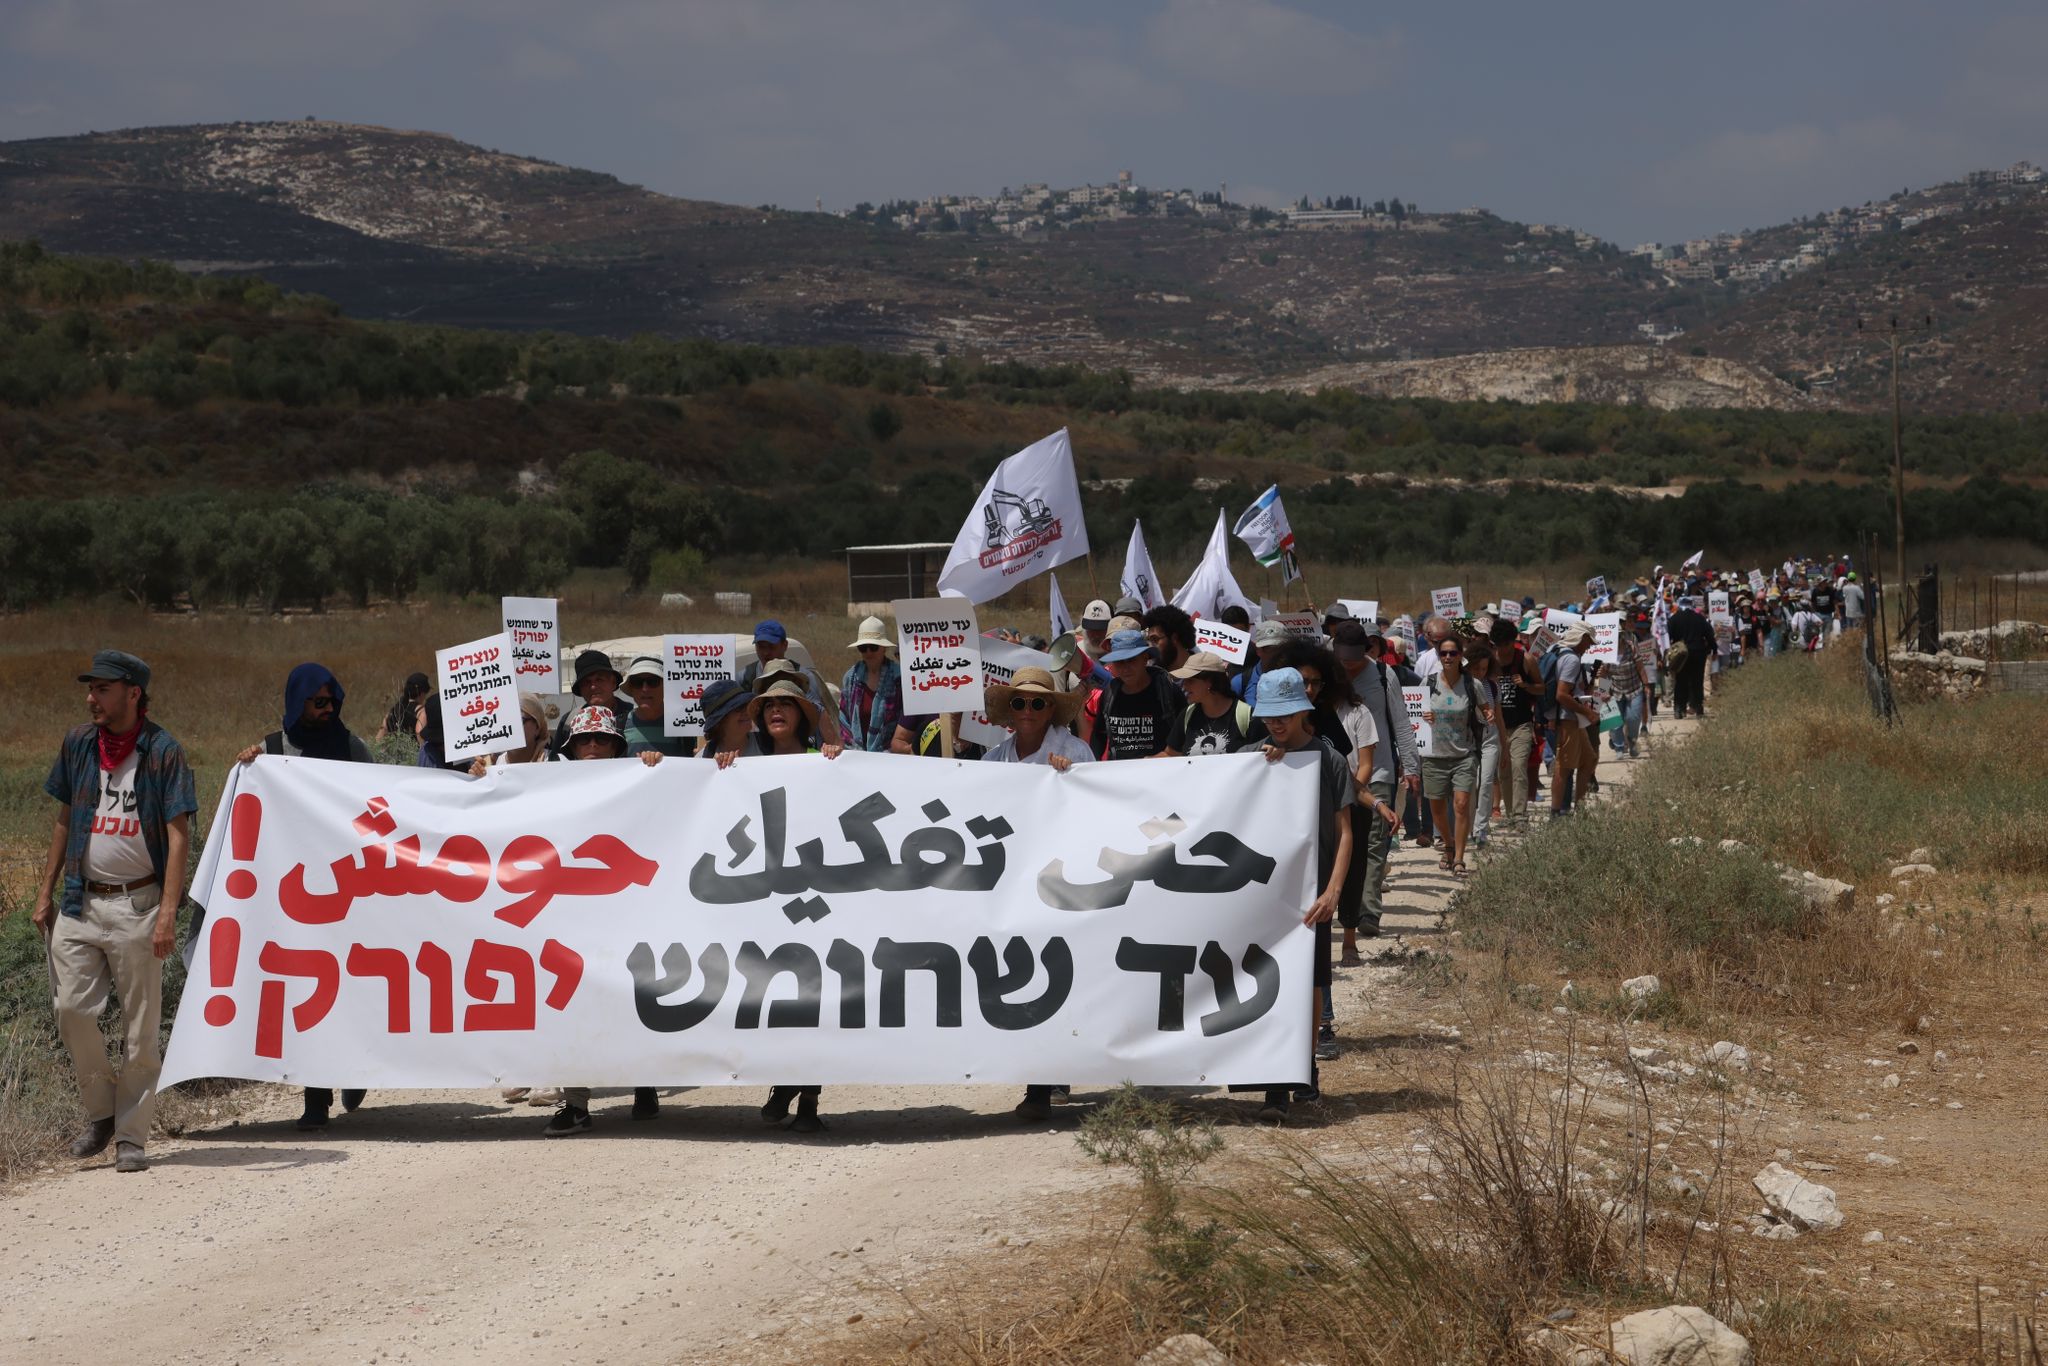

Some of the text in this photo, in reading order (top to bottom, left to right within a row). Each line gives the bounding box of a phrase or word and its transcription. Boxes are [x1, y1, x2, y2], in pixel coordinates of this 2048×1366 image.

[507, 619, 553, 629] עד שחומש
[903, 619, 971, 634] עד שחומש
[514, 629, 548, 644] יפורק!
[914, 634, 965, 654] יפורק!
[1197, 637, 1239, 653] سلام
[1199, 627, 1242, 645] שלום
[448, 647, 499, 671] עוצרים
[512, 647, 551, 660] حتى تفكيك
[674, 645, 724, 656] עוצרים
[675, 659, 722, 668] את טרור
[909, 656, 971, 673] حتى تفكيك
[982, 660, 1017, 678] חומש
[450, 663, 500, 683] את טרור
[667, 669, 731, 681] המתנחלים!
[444, 675, 512, 700] המתנחלים!
[681, 684, 704, 699] قف
[460, 695, 500, 716] نوقف
[1410, 702, 1422, 710] את
[466, 714, 497, 734] ارهاب
[1118, 726, 1153, 734] עם כיבוש
[1141, 717, 1153, 726] אין
[454, 725, 512, 749] المستوطنين
[96, 773, 137, 813] שלו
[90, 816, 140, 837] עכש
[689, 786, 1014, 924] تفكيك
[1036, 812, 1277, 911] حتى
[203, 917, 1280, 1059] עד שחומש יפורק!
